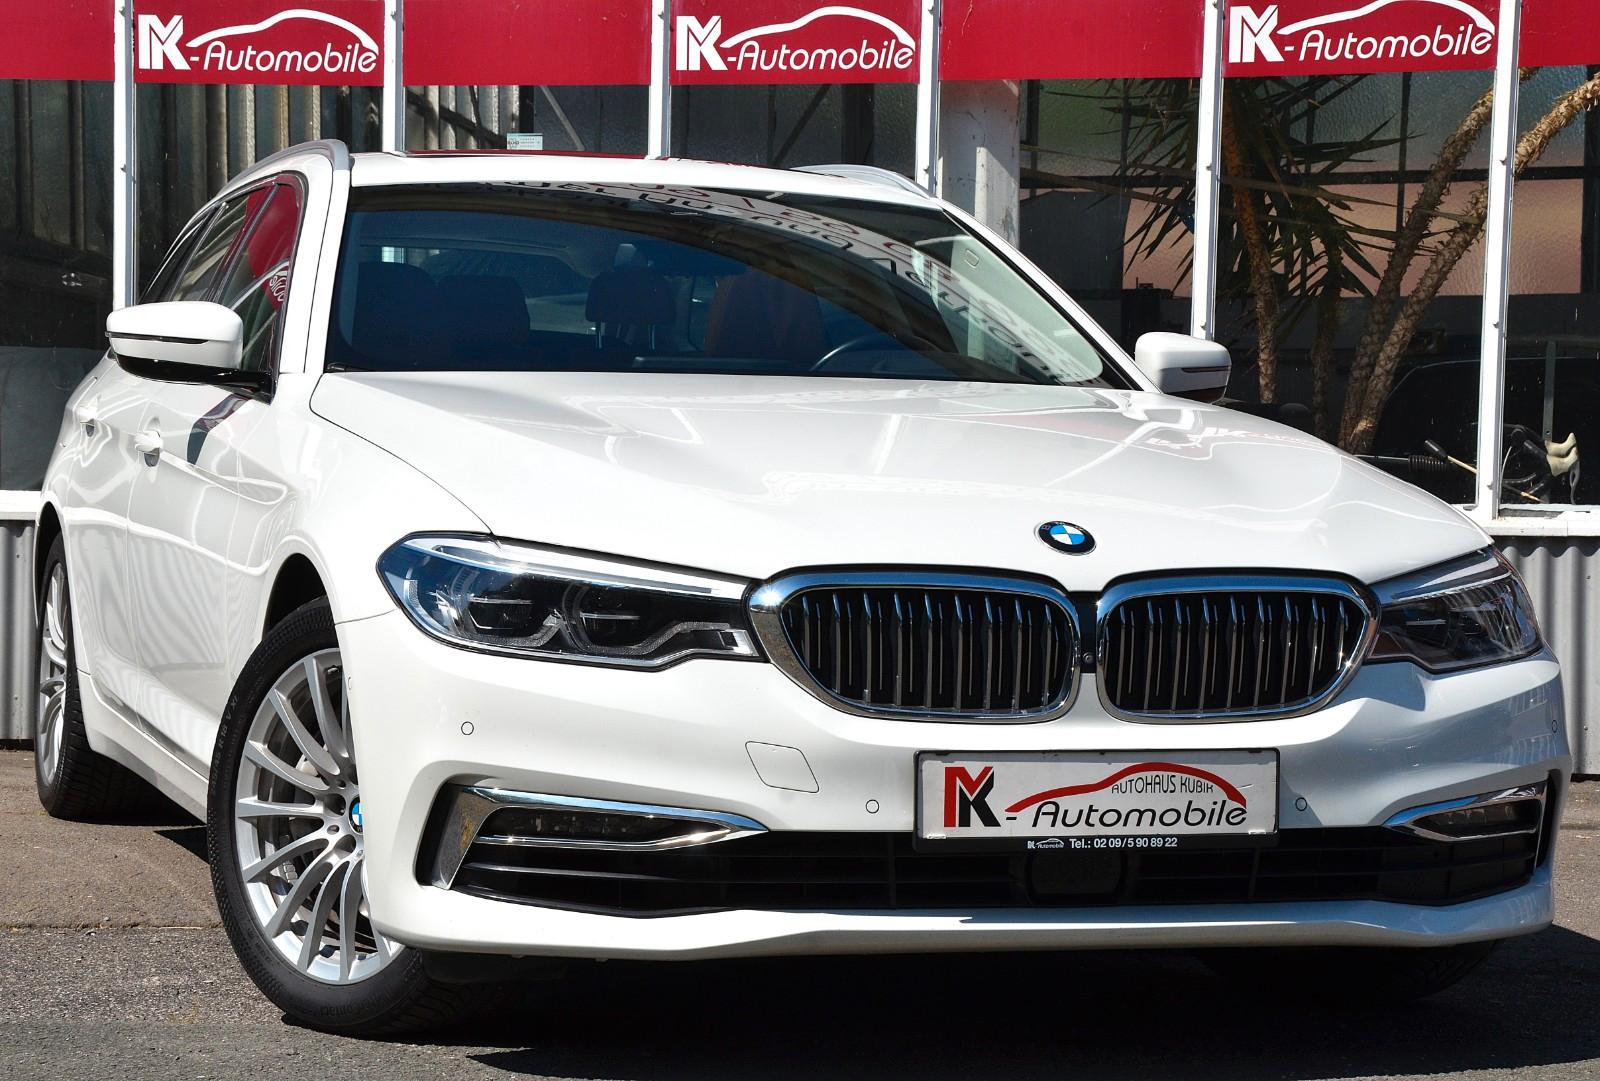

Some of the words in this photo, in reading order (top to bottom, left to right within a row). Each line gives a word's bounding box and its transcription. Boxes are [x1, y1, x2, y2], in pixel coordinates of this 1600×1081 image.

[1111, 774, 1176, 794] AUTOHAUS
[1179, 775, 1214, 794] KUBIK
[1069, 838, 1091, 849] Tel.:
